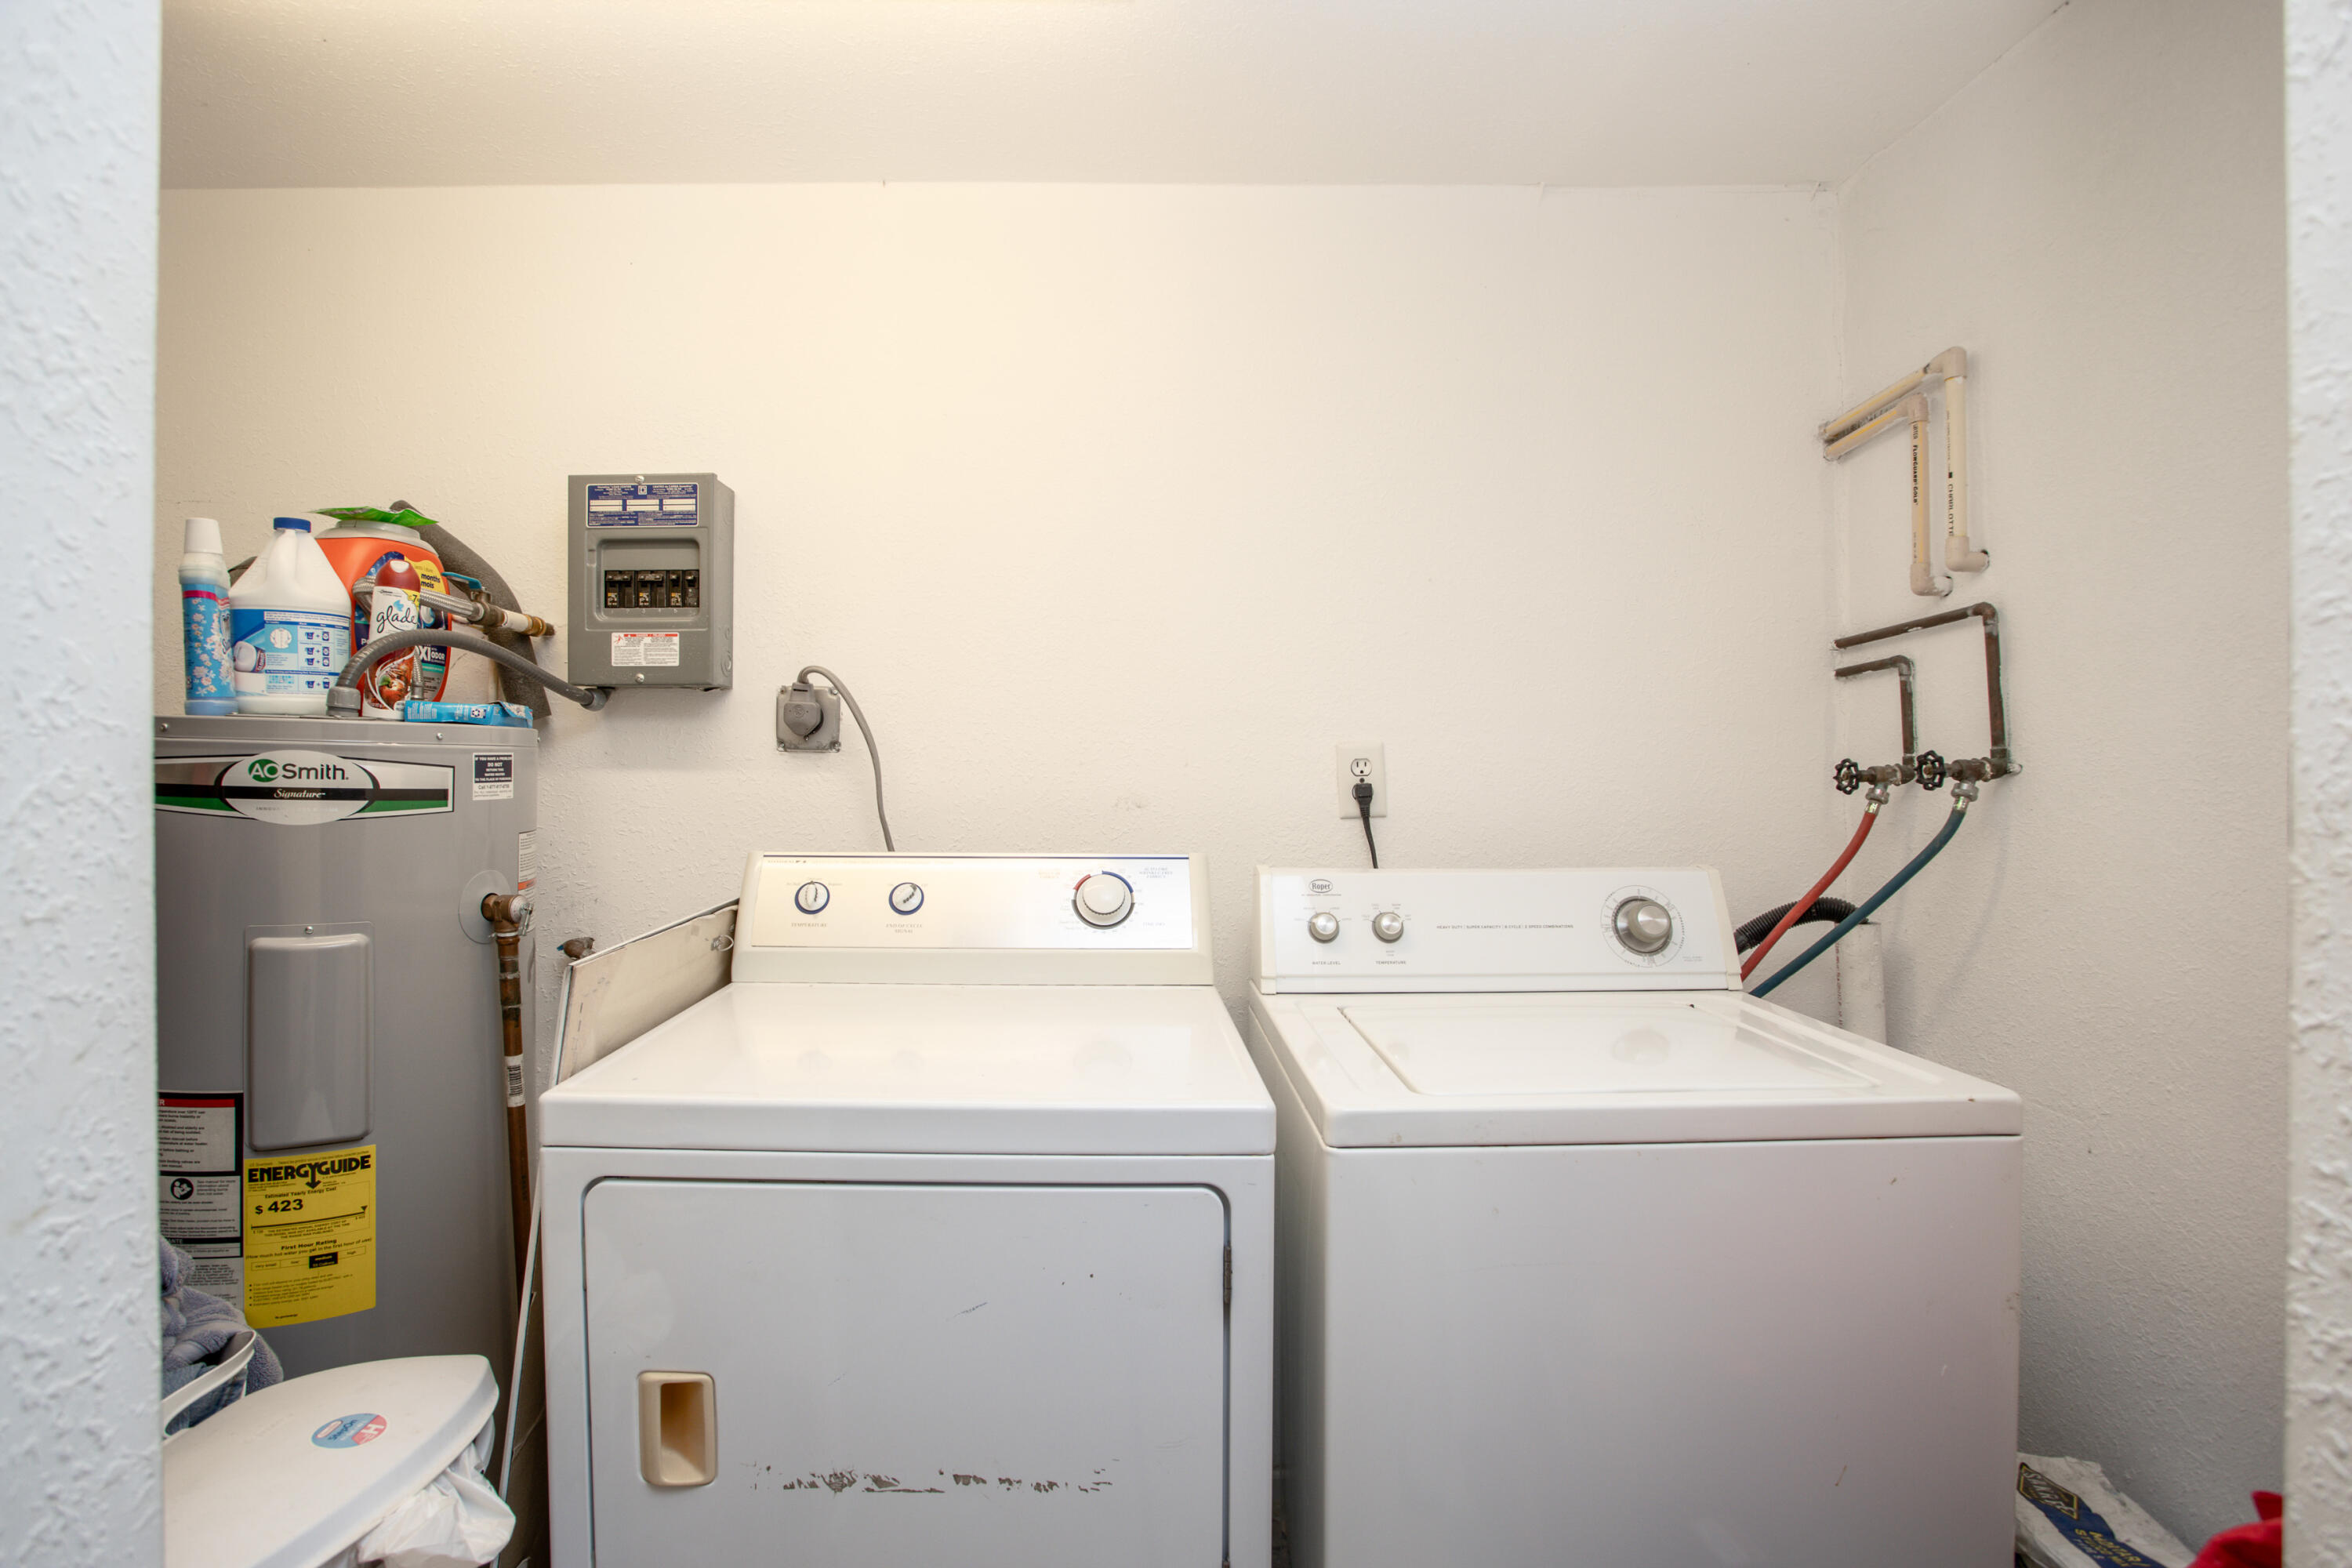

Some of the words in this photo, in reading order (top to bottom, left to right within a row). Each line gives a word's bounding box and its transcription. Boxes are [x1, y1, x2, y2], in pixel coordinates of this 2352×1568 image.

[421, 573, 440, 583] months
[376, 605, 418, 633] glade
[431, 652, 445, 661] ODOR
[248, 1155, 371, 1185] ENERGYGUIDE
[255, 1205, 263, 1215] $
[268, 1199, 303, 1212] 423
